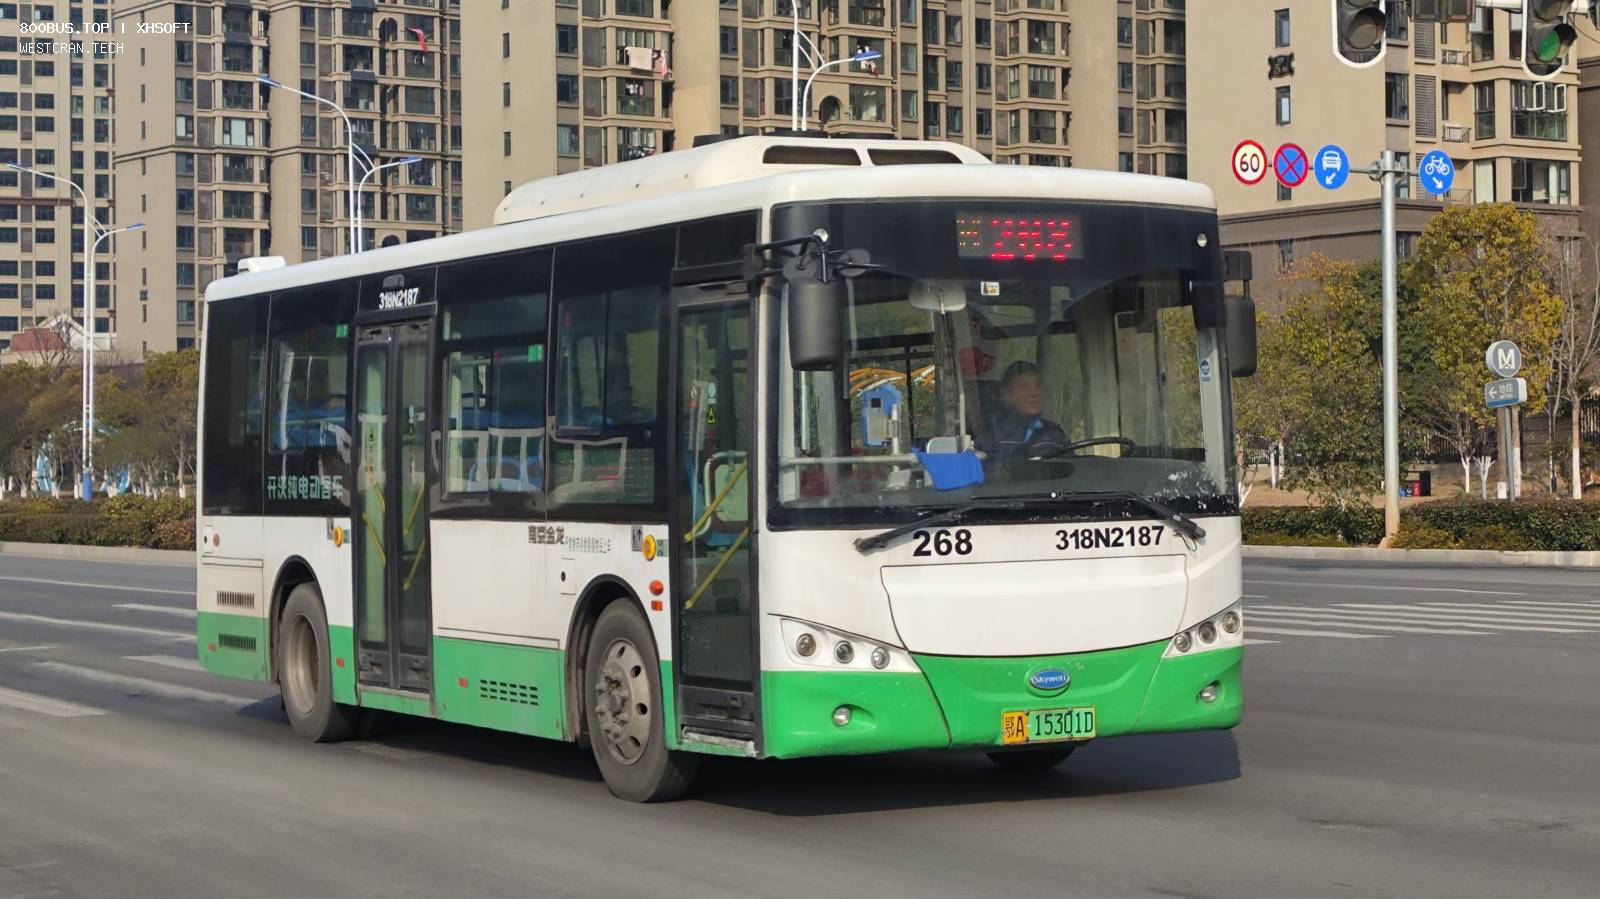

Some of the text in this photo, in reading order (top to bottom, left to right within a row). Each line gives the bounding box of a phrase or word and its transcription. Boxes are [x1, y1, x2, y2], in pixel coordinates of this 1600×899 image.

[1239, 152, 1260, 173] 60
[378, 287, 419, 310] 318N2187
[267, 474, 344, 500] 开沃纯电动客车
[912, 529, 973, 557] 268
[1055, 525, 1165, 551] 318N2187
[1035, 711, 1094, 737] 15301D
